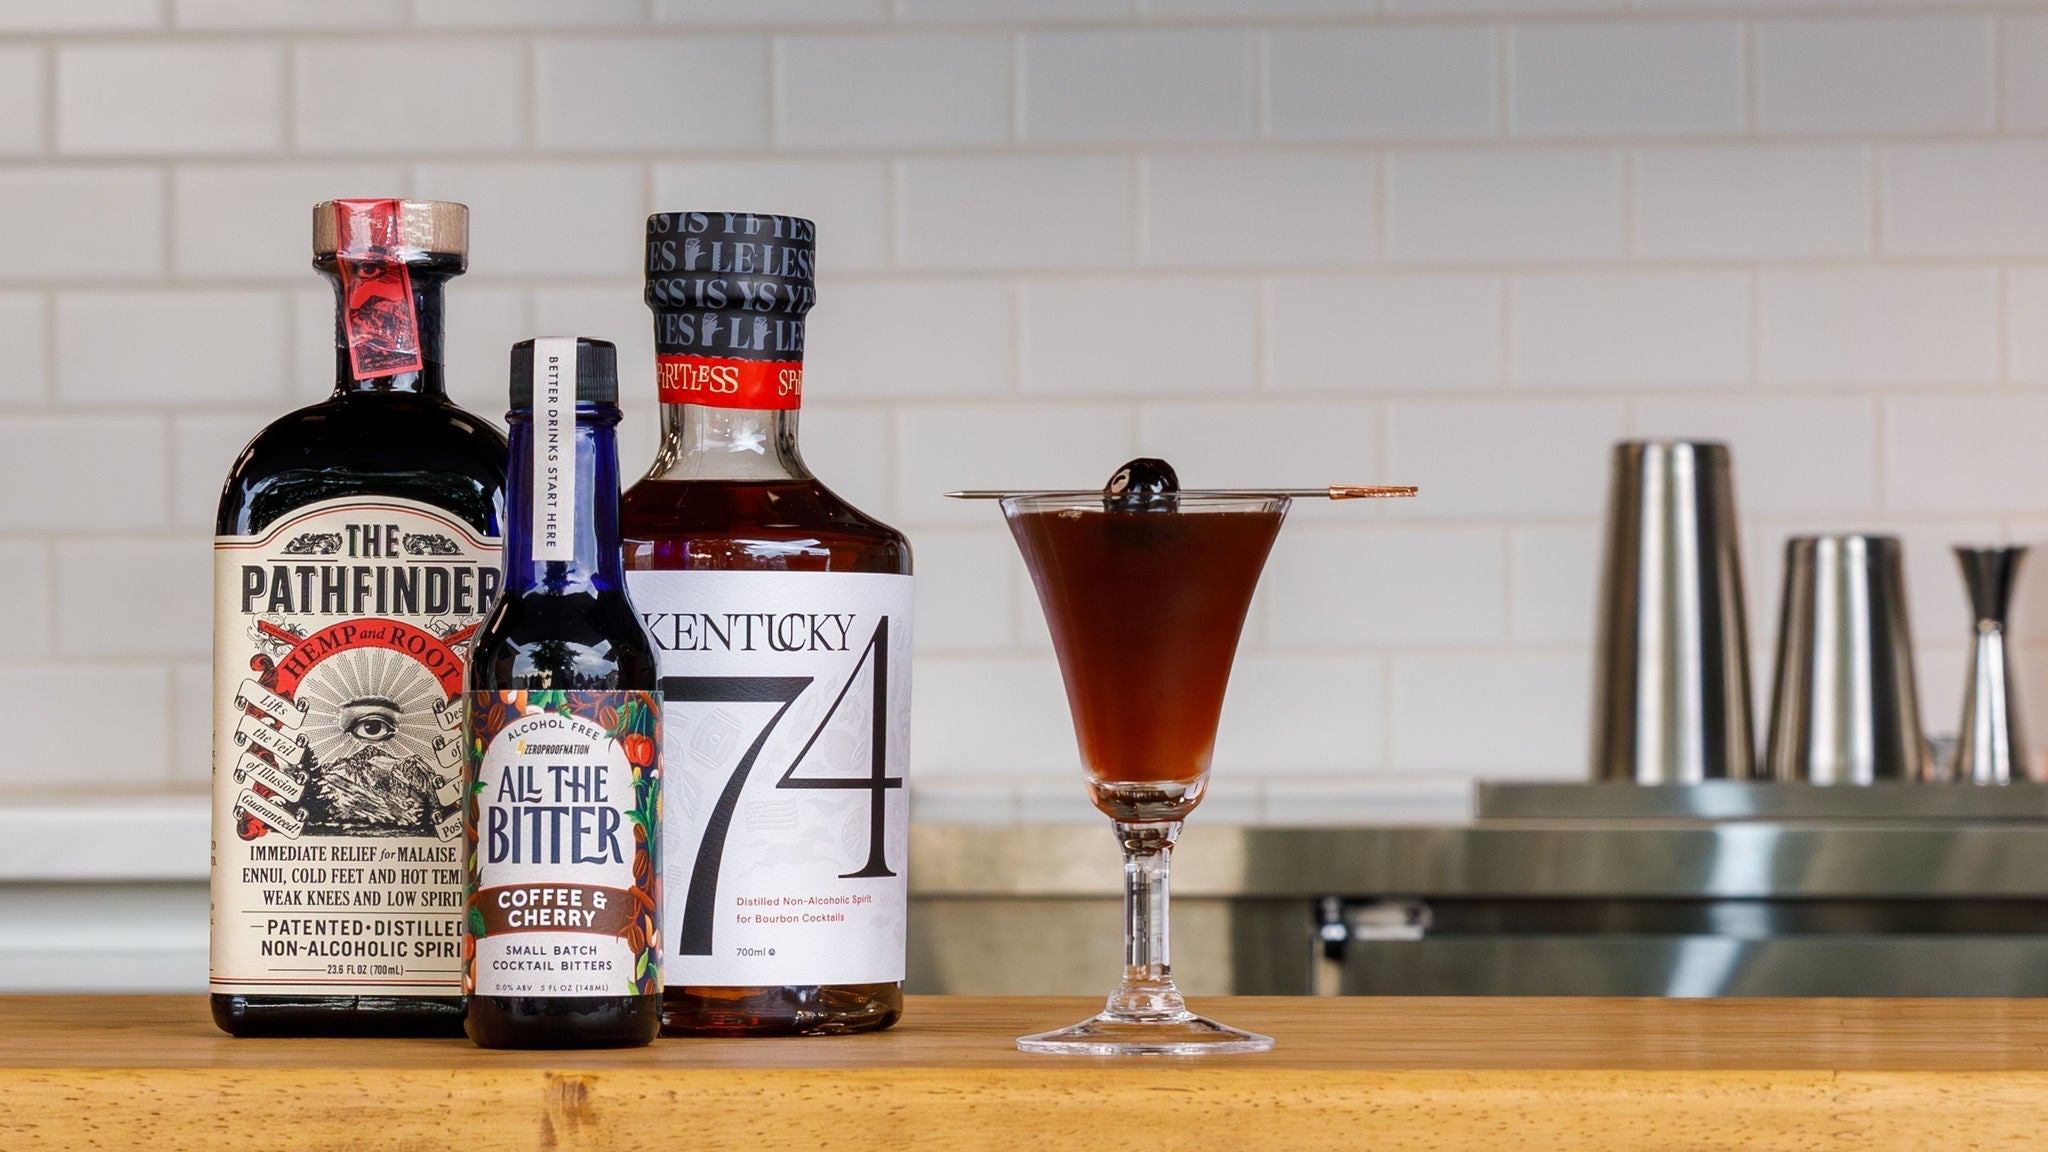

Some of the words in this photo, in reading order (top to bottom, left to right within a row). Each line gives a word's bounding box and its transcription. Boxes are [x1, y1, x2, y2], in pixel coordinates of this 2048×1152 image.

[695, 278, 728, 309] IS
[548, 356, 559, 404] BETTER
[548, 409, 558, 462] DRINKS
[547, 467, 558, 508] START
[345, 524, 401, 558] THE
[546, 513, 557, 548] HERE
[240, 565, 501, 616] PATHFINDER
[641, 613, 856, 652] KENTUCKY
[282, 625, 357, 680] HEMP
[359, 627, 386, 641] and
[388, 626, 460, 682] ROOT
[259, 694, 289, 716] Lifts
[252, 727, 272, 745] the
[272, 738, 296, 757] Veil
[507, 719, 565, 742] ALCOHOL
[570, 722, 600, 741] FREE
[524, 744, 590, 755] ZEROPROOFNATION
[246, 759, 261, 773] of
[257, 763, 298, 797] Illusion
[497, 765, 542, 803] ALL
[547, 765, 609, 803] THE
[657, 615, 903, 956] 74
[241, 795, 301, 834] Guaranteed!
[488, 806, 624, 865] BITTER
[250, 846, 327, 862] IMMEDIATE
[331, 846, 377, 862] RELIEF
[379, 847, 396, 863] for
[397, 846, 457, 863] MALAISE
[242, 868, 287, 886] ENNUI,
[291, 868, 327, 884] COLD
[331, 868, 364, 884] FEET
[368, 869, 396, 885] AND
[400, 869, 428, 885] HOT
[263, 890, 303, 906] WEAK
[307, 891, 350, 907] KNEES
[353, 891, 381, 907] AND
[387, 891, 417, 907] LOW
[498, 888, 583, 909] COFFEE
[592, 890, 608, 910] &
[736, 896, 780, 907] Distilled
[783, 895, 850, 906] Non-Alcoholic
[852, 894, 872, 906] Spirit
[508, 908, 596, 928] CHERRY
[736, 914, 752, 924] for
[755, 913, 799, 924] Bourbon
[802, 913, 845, 923] Cocktails
[506, 945, 547, 956] SMALL
[553, 945, 597, 956] BATCH
[736, 947, 766, 957] 700ml
[327, 965, 344, 975] 23.6
[347, 965, 356, 975] FL
[357, 966, 367, 975] OZ
[370, 965, 404, 976] (700mL)
[492, 960, 554, 971] COCKTAIL
[561, 960, 612, 971] BITTERS
[495, 984, 514, 992] 0.0%
[516, 984, 532, 992] ABV
[548, 984, 557, 992] FL
[560, 984, 573, 992] OZ
[575, 984, 609, 993] (148ML)
